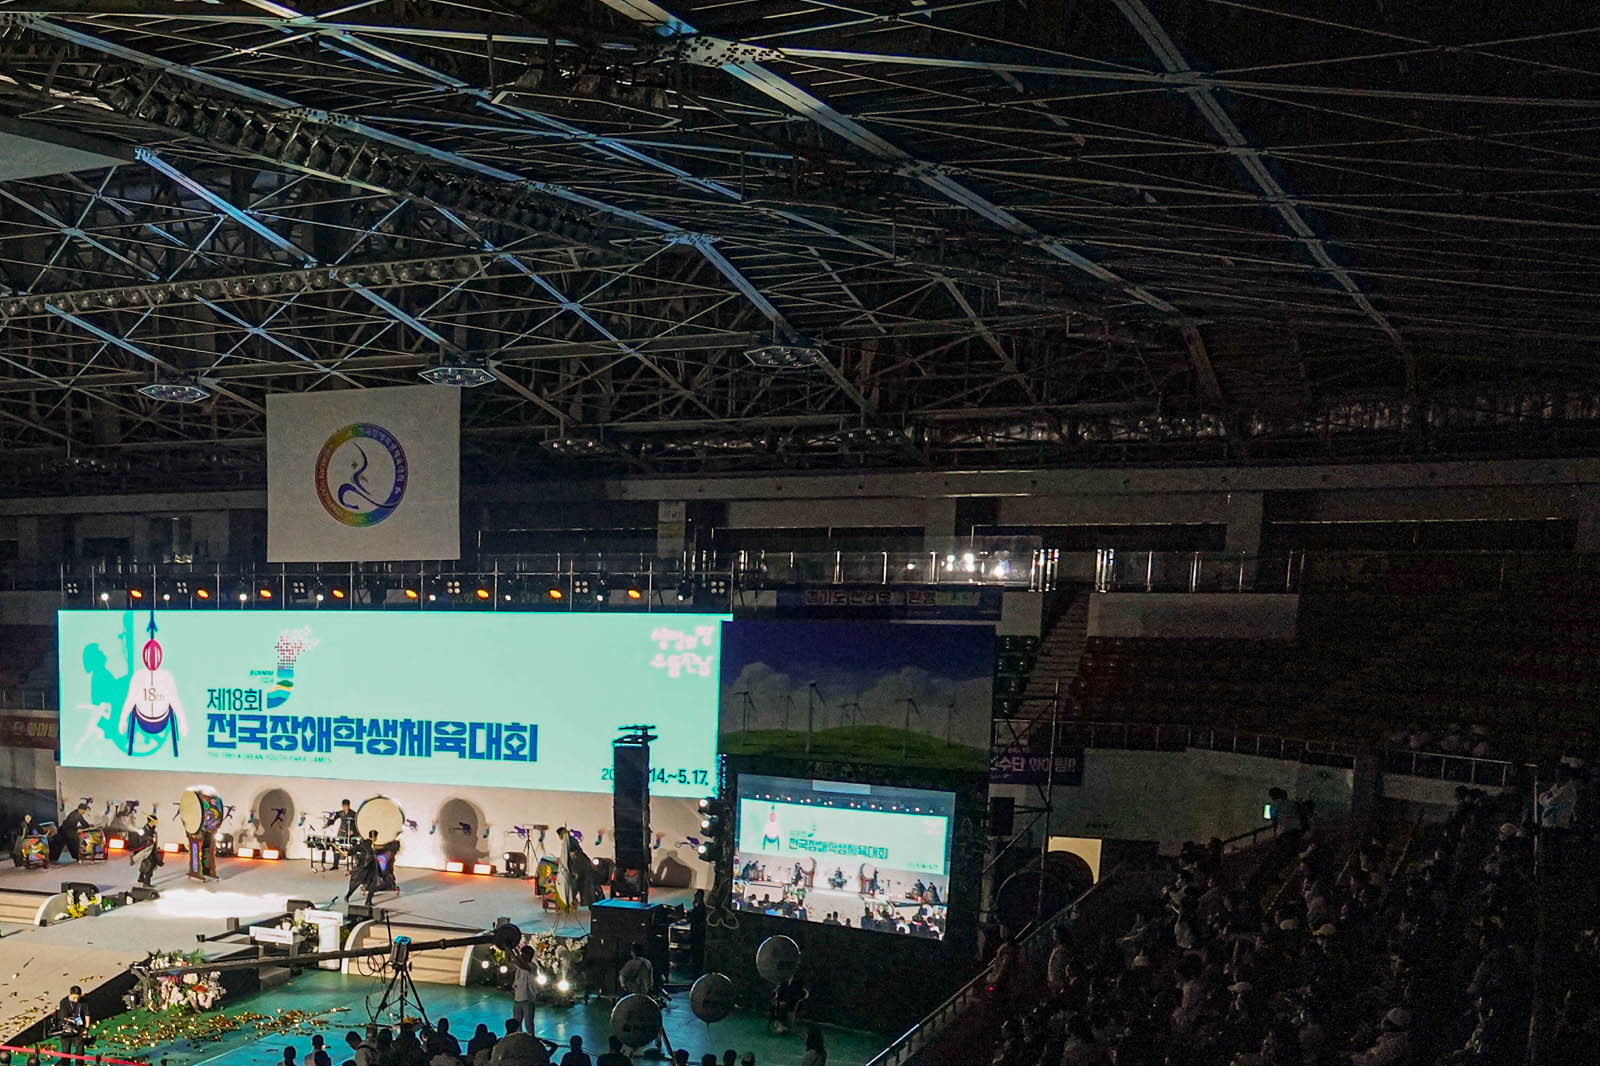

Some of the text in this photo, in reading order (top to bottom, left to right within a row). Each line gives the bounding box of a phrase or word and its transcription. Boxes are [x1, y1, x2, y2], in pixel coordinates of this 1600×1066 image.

[206, 687, 263, 712] 제18회
[206, 713, 539, 763] 전국장애학생체육대회
[650, 768, 709, 785] 14.~5.17.
